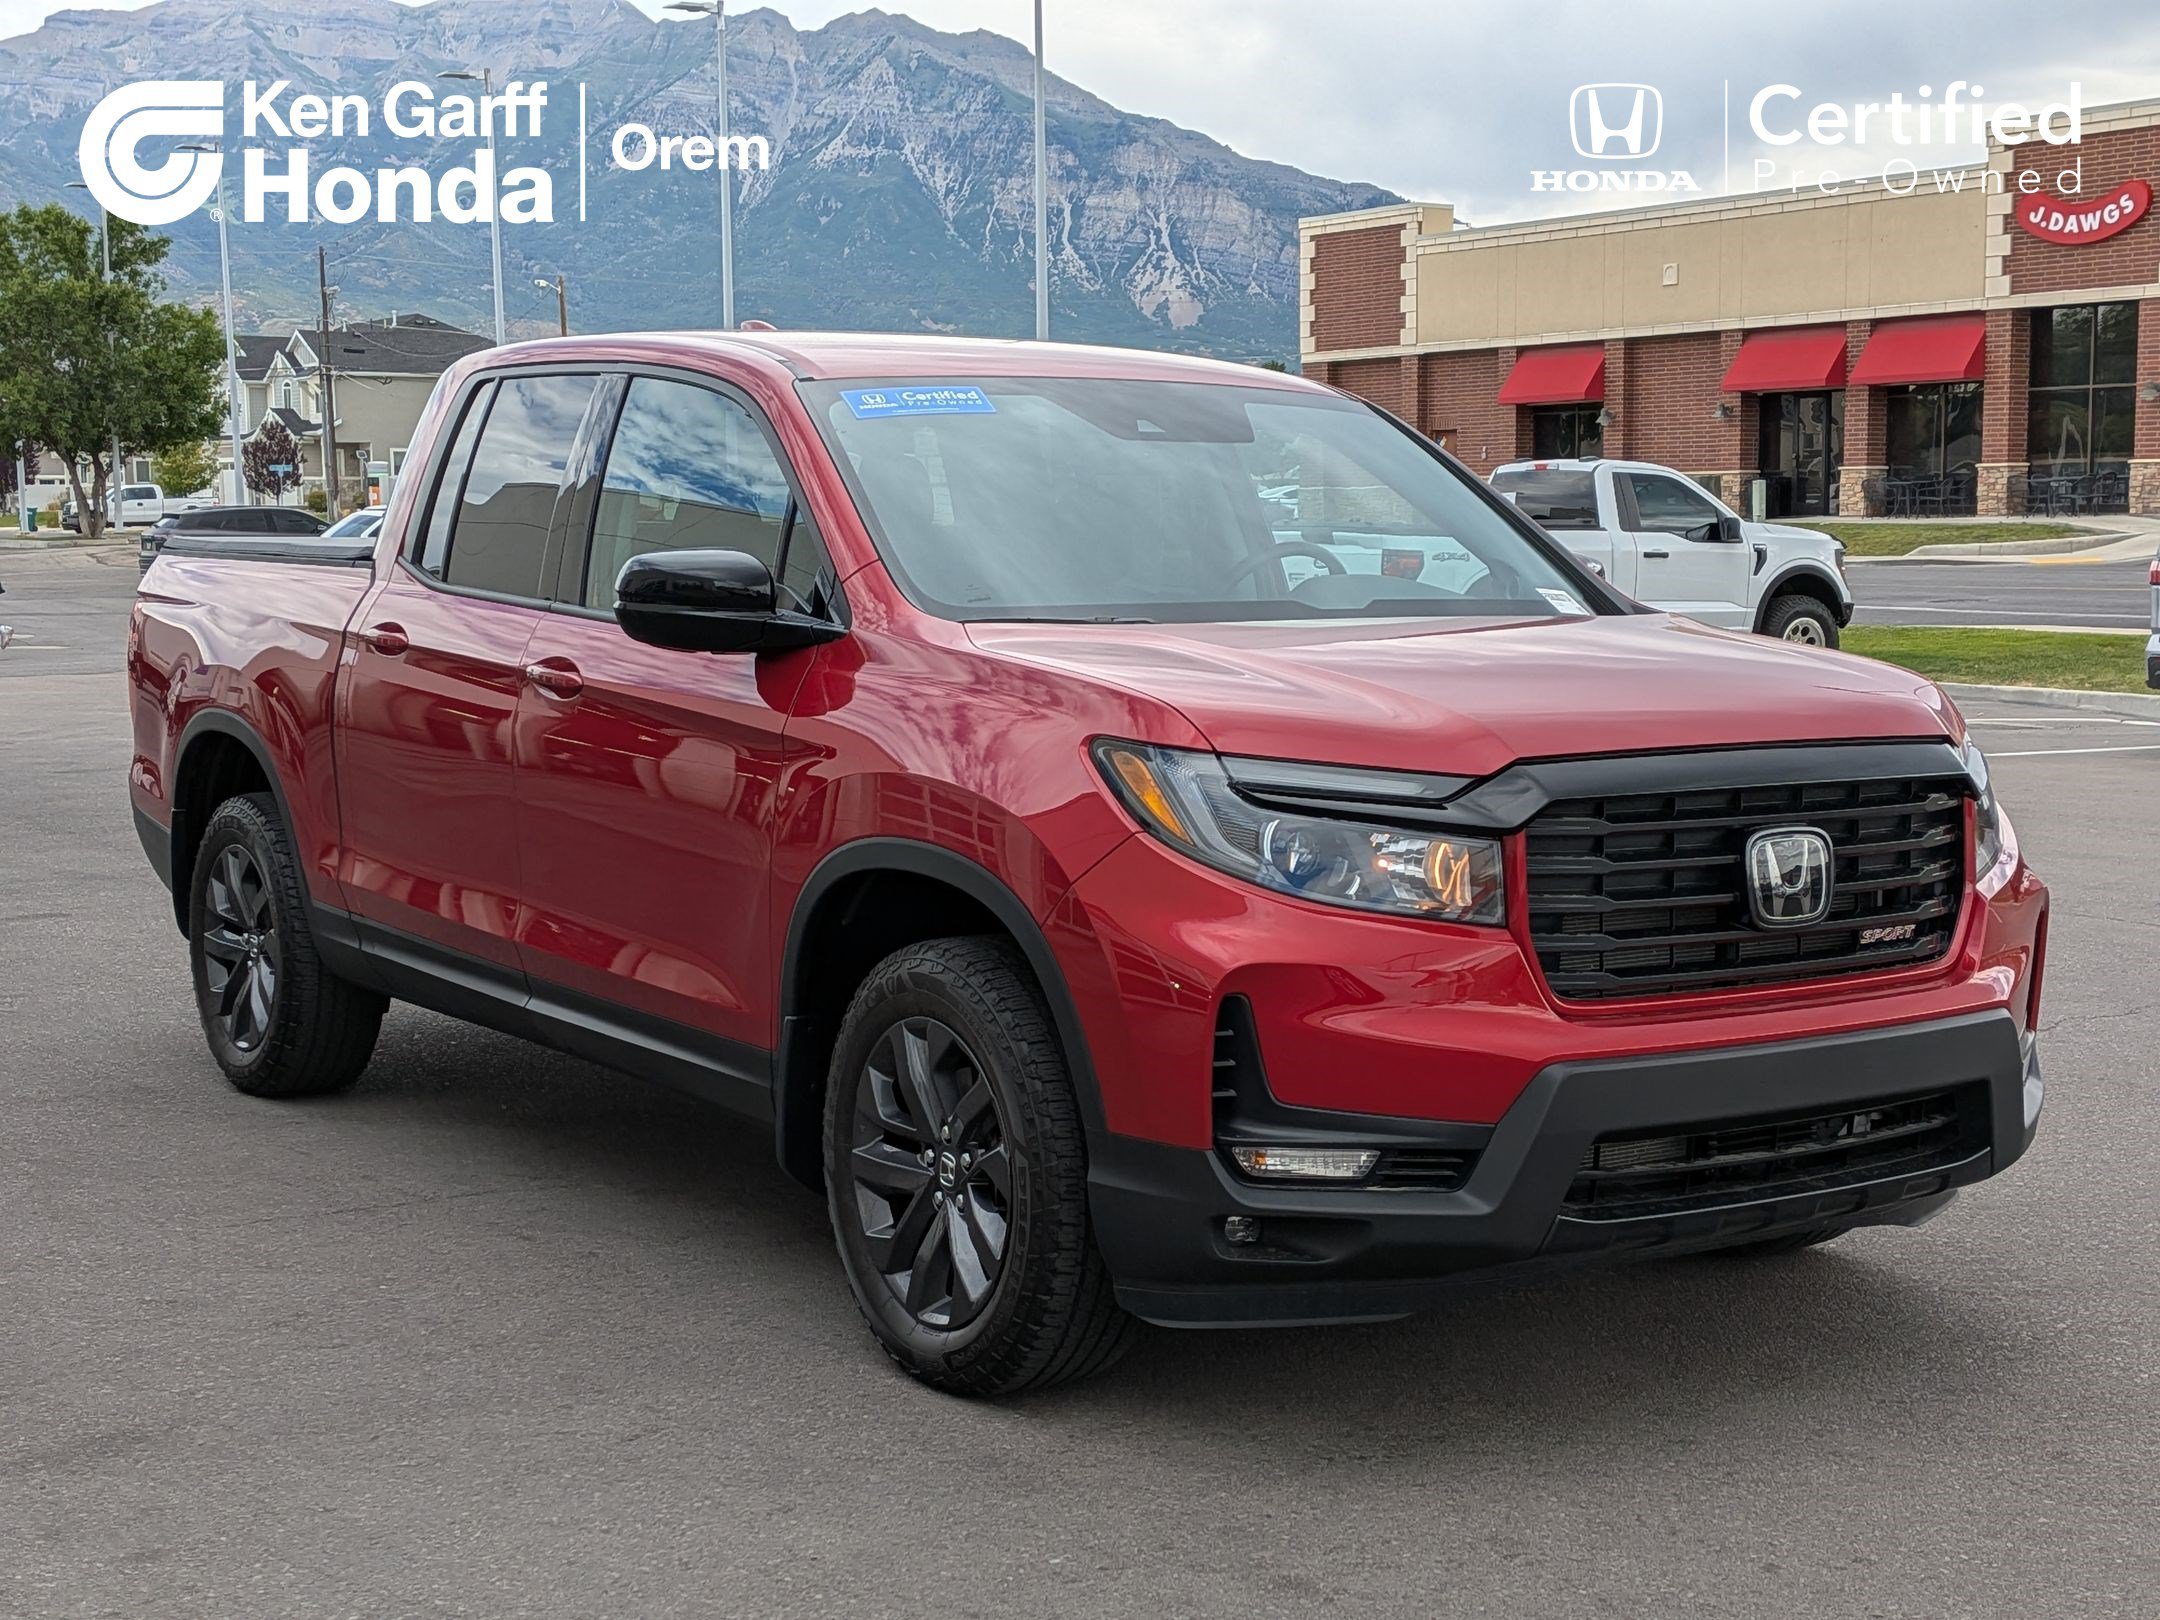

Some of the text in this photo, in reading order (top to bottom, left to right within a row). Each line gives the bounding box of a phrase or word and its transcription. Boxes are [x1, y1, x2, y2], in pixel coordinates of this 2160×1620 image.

[2028, 193, 2135, 234] J.DAWGS
[902, 390, 979, 400] Certified
[1860, 924, 1917, 944] SPORT
